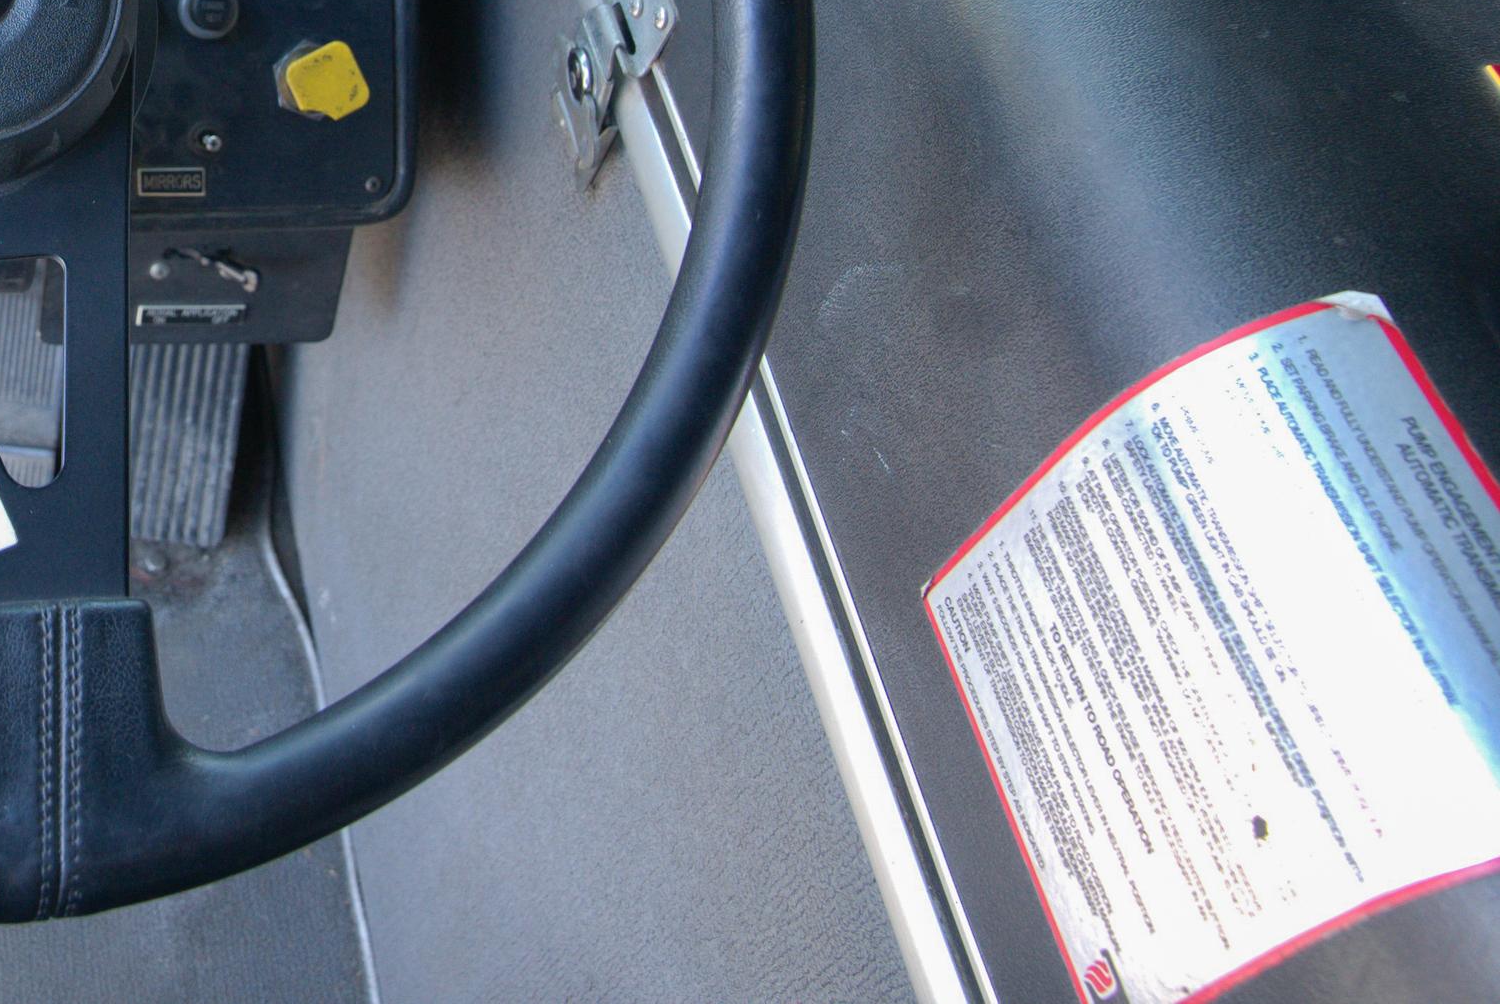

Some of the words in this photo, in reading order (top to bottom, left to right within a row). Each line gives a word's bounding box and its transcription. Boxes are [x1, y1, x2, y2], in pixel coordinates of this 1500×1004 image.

[144, 174, 201, 189] MIRRORS
[1157, 416, 1180, 447] MOVE
[1279, 356, 1300, 381] SET
[1291, 376, 1325, 424] PARKING
[1316, 422, 1347, 461] BRAKE
[1339, 460, 1362, 484] AND
[1353, 481, 1376, 509] IDLE
[1304, 347, 1329, 378] READ
[1322, 376, 1343, 401] AND
[1335, 398, 1363, 433] FULLY
[1355, 432, 1406, 507] UNDERSTAND
[1399, 506, 1427, 542] PUMP
[1400, 413, 1438, 462] PUMP
[1158, 442, 1173, 459] TO
[1184, 492, 1210, 530] GREEN
[1255, 366, 1282, 400] PLACE
[1274, 398, 1317, 461] AUTOMATIC
[1309, 460, 1363, 541] TRANSMISSION
[1354, 539, 1382, 574] SHIFT
[1375, 574, 1419, 638] SELECTOR
[1394, 439, 1460, 530] AUTOMATIC
[1451, 530, 1500, 607] TRANSM
[1121, 439, 1147, 479] SAFETY
[1140, 477, 1165, 514] LATCH
[1158, 512, 1191, 566] PROVIDED
[1184, 563, 1199, 582] TO
[1192, 581, 1224, 631] PREVENT
[990, 560, 1010, 594] PLACE
[1004, 593, 1020, 616] THE
[1129, 433, 1152, 465] LOCK
[1144, 462, 1182, 524] AUTOMATIC
[1174, 522, 1221, 602] TRANSMISSION
[1213, 599, 1237, 633] SHIFT
[1230, 632, 1268, 694] SELECTOR
[1261, 692, 1275, 708] IN
[1268, 705, 1298, 751] DIRECT
[1290, 750, 1317, 789] DRIVE
[941, 595, 973, 654] CAUTION
[1001, 550, 1029, 601] THROTTLE
[1022, 599, 1045, 638] ENGINE
[1038, 636, 1057, 667] BACK
[1051, 666, 1064, 682] TO
[1014, 614, 1034, 648] TRUCK
[935, 603, 957, 644] FOLLOW
[951, 642, 964, 663] THE
[959, 661, 991, 729] PROCEDURES
[985, 728, 1001, 755] STEP
[995, 754, 1007, 771] BY
[1001, 770, 1017, 797] STEP
[1012, 797, 1023, 813] AS
[979, 570, 996, 597] WAIT
[993, 603, 1020, 652] SECONDS
[1013, 650, 1029, 673] FOR
[1022, 671, 1041, 703] DRIVE
[1035, 701, 1055, 736] SHAFT
[1049, 736, 1062, 753] TO
[1056, 751, 1074, 781] STOP
[1028, 646, 1066, 723] TRANSMISSION
[1046, 621, 1064, 644] TO
[1056, 643, 1089, 703] RETURN
[1080, 700, 1098, 724] TO
[1090, 723, 1118, 768] ROAD
[1110, 767, 1157, 856] OPERATION
[1060, 722, 1089, 778] SELECTOR
[1084, 777, 1105, 814] LEVER
[1099, 813, 1110, 827] IN
[1104, 826, 1132, 878] NEUTRAL
